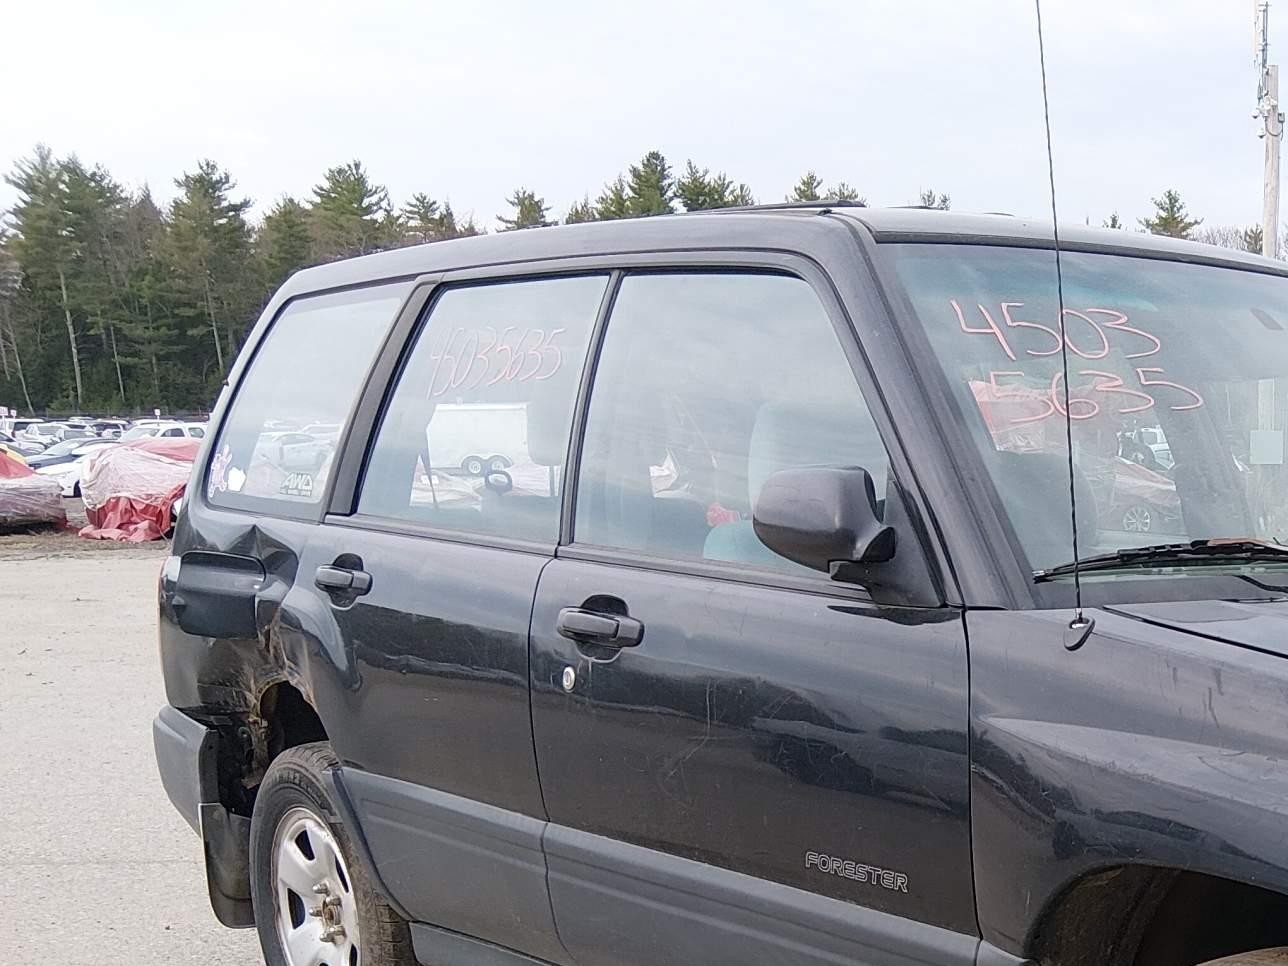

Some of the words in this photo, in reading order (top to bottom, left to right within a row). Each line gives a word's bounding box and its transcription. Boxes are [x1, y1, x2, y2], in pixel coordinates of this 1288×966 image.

[950, 299, 1161, 361] 4503
[989, 367, 1204, 423] 5635
[805, 851, 908, 893] FORESTER
